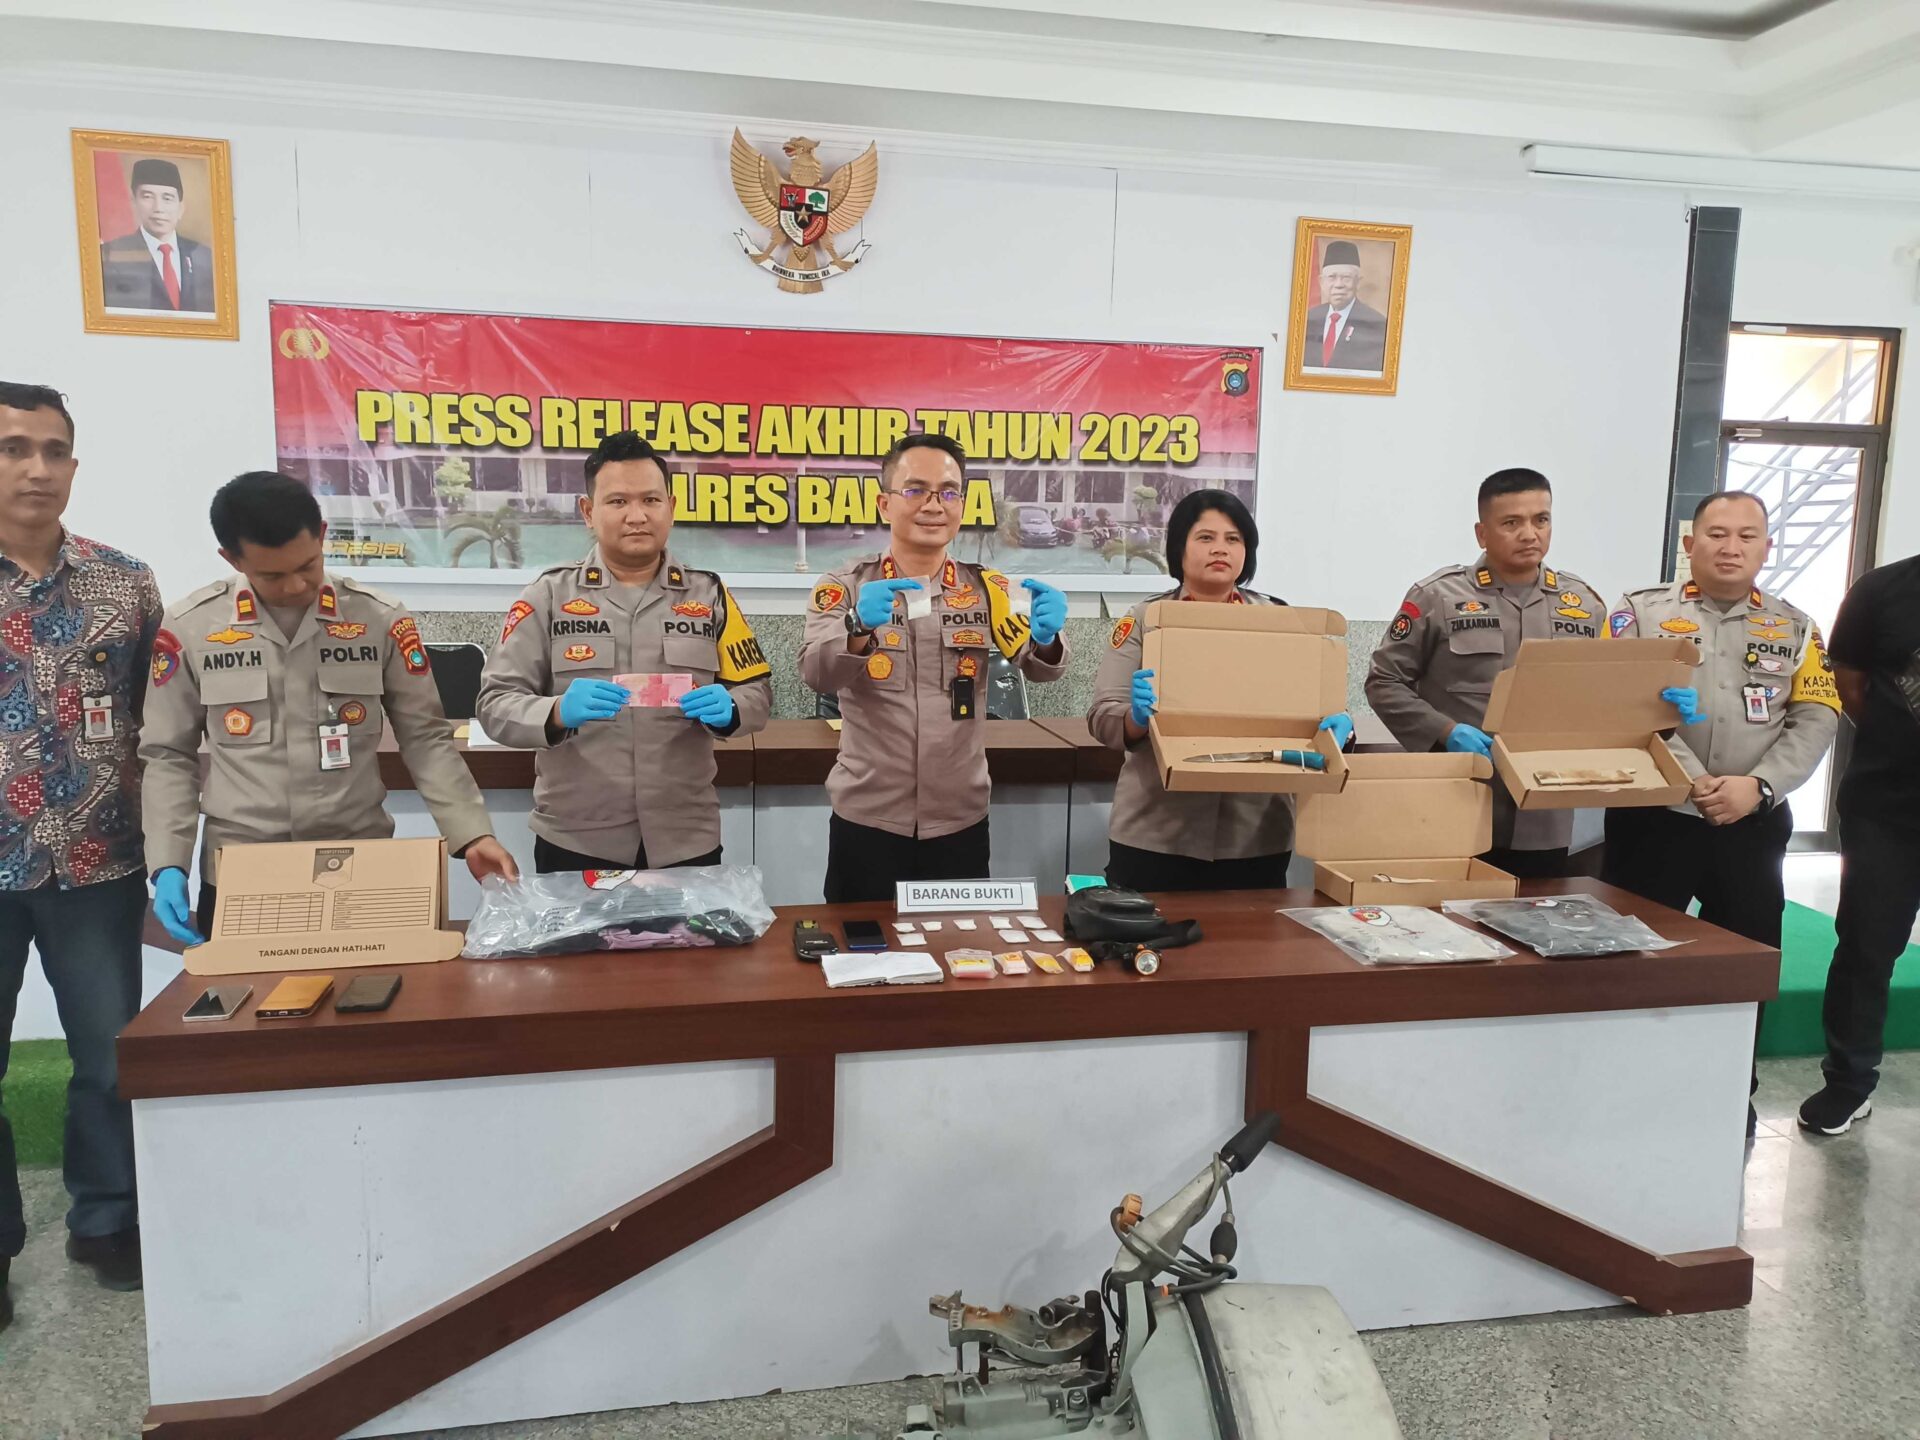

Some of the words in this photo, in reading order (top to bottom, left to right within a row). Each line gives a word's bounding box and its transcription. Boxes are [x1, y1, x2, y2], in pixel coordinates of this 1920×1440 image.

[356, 390, 532, 448] PRESS
[541, 397, 750, 453] RELEASE
[757, 404, 908, 456] AKHIR
[916, 410, 1072, 461] TAHUN
[1079, 413, 1200, 463] 2023
[671, 472, 788, 525] LRES
[799, 475, 996, 527] BANA
[942, 611, 988, 626] POLRI
[553, 619, 611, 636] KRISNA
[664, 621, 715, 638] POLRI
[1554, 621, 1595, 639] POLRI
[319, 646, 379, 664] POLRI
[1747, 642, 1792, 659] POLRI
[203, 650, 263, 671] ANDY.H
[912, 888, 971, 900] BARANG
[974, 888, 1014, 899] BUKTI
[259, 948, 299, 958] TANGANI
[301, 946, 340, 955] DENGAN
[342, 944, 386, 953] HATI-HATI
